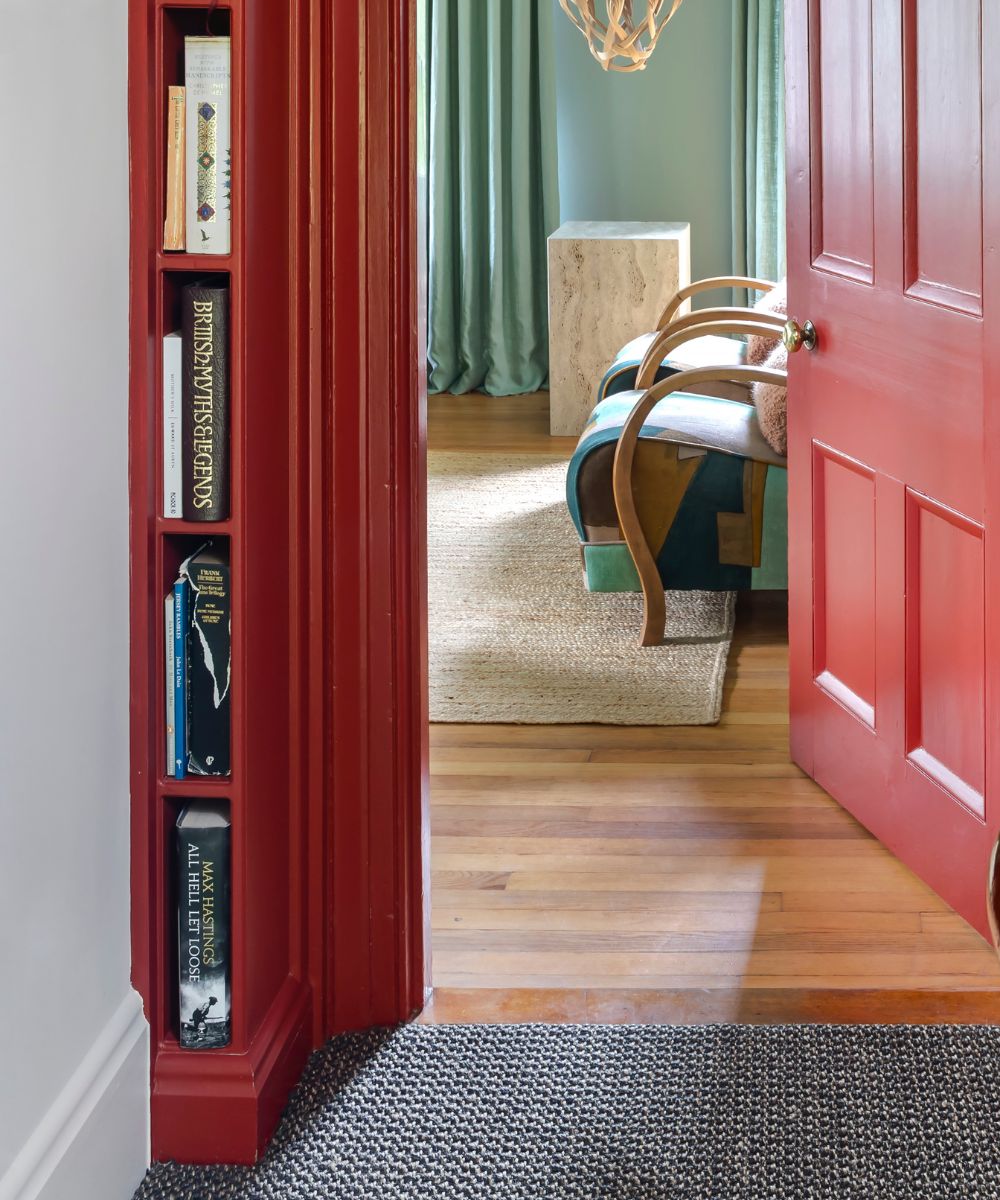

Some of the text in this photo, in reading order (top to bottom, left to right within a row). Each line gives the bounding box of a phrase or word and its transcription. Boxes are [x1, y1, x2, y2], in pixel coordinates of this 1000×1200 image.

[192, 300, 214, 510] BRITISH MYTHS LEGENDS
[187, 843, 200, 983] ALL HELL LET LOOSE
[202, 861, 215, 966] MAX HASTINGS
